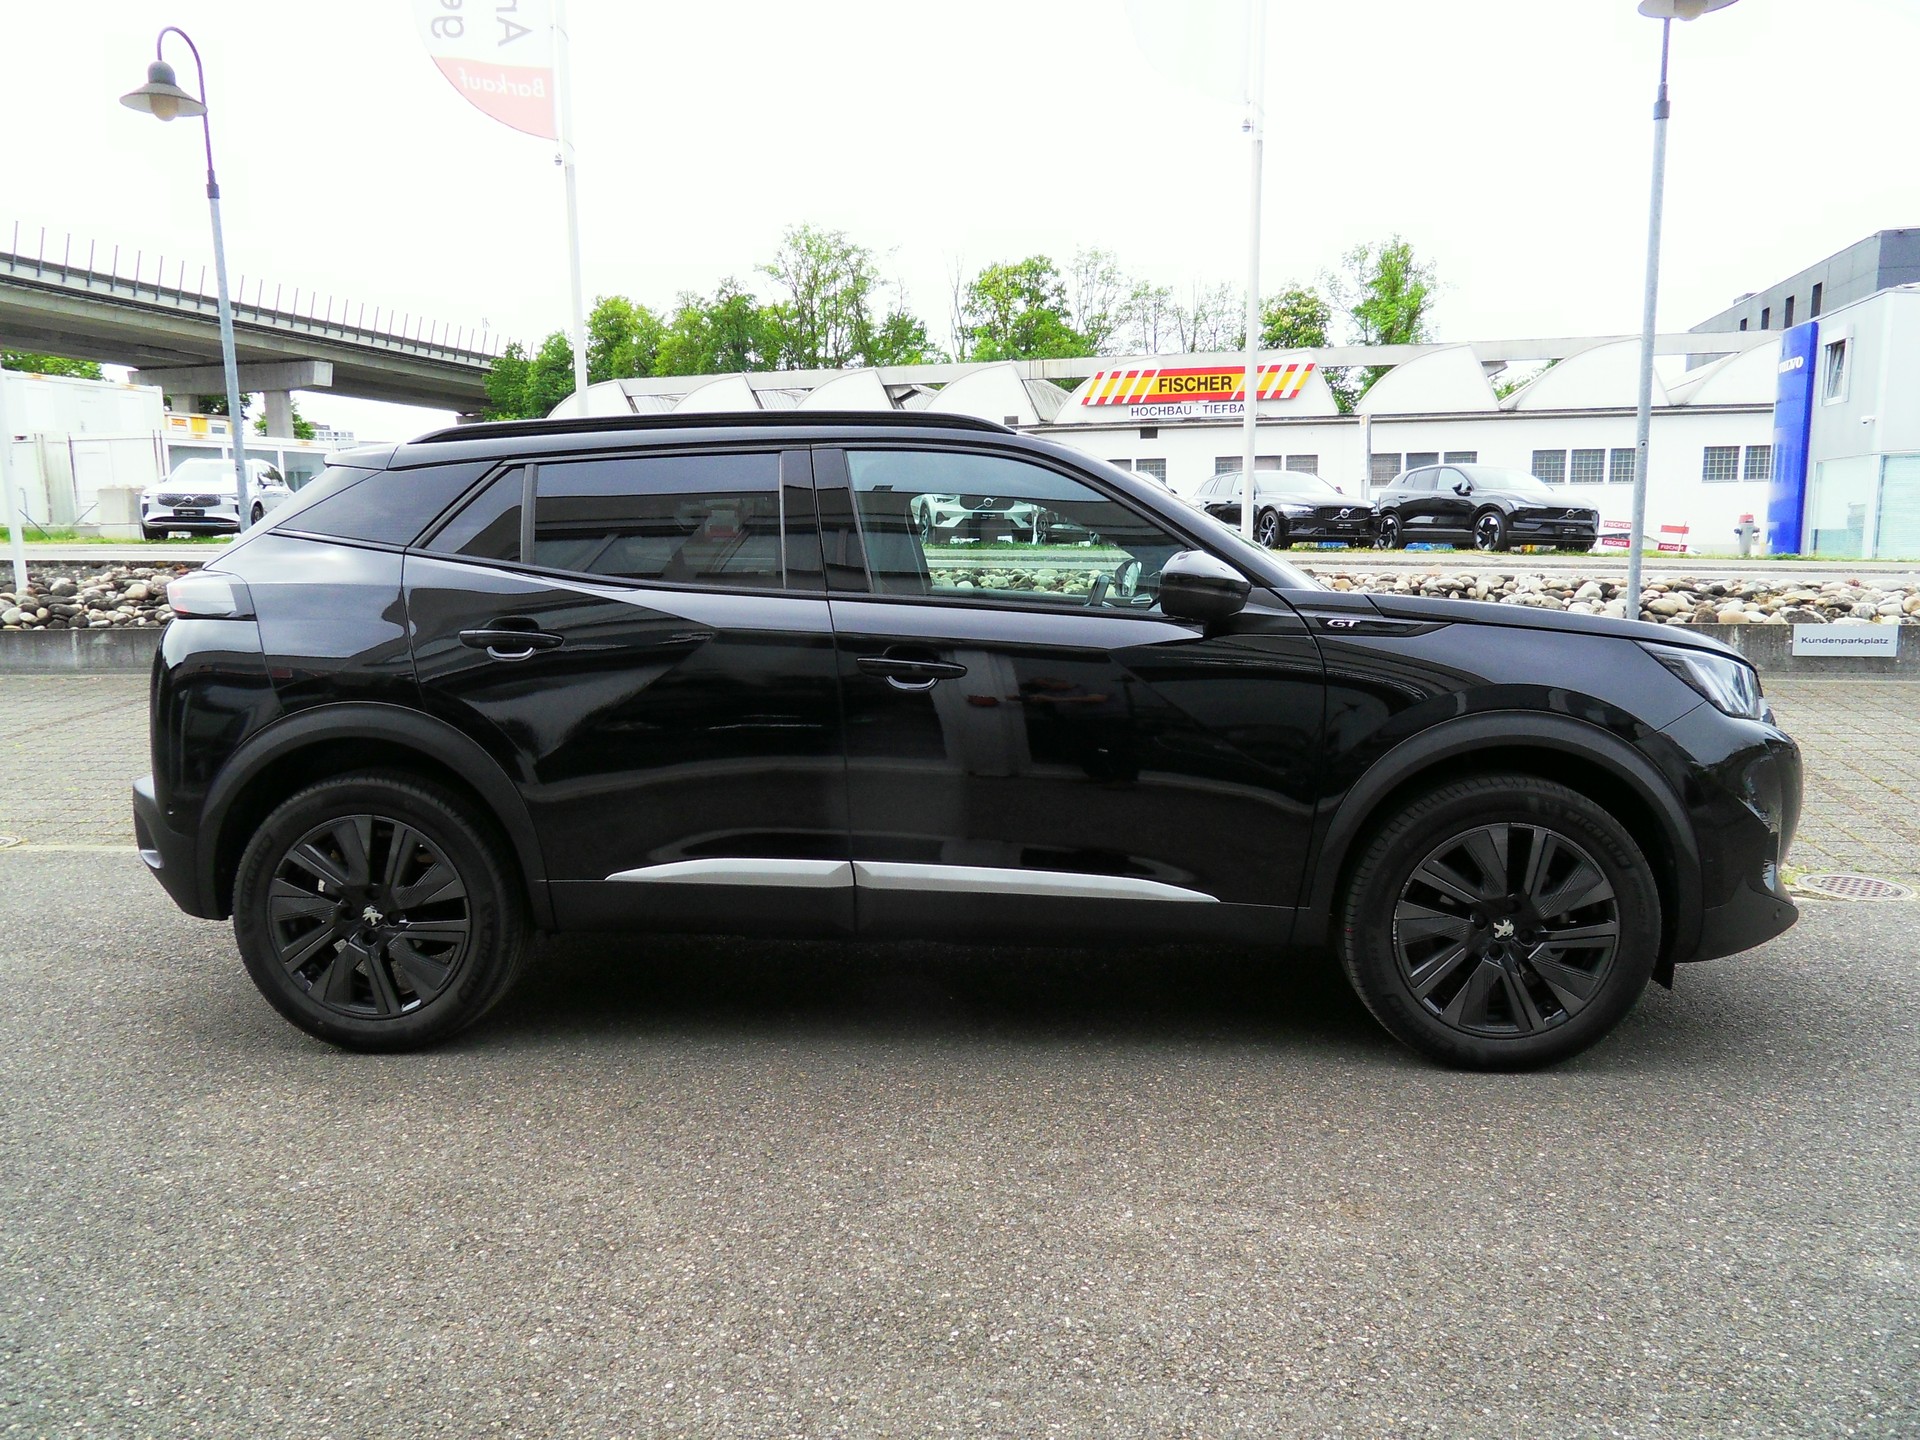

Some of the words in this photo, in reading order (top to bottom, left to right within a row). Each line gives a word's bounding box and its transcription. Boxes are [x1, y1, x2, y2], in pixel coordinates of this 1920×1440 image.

[1159, 376, 1232, 393] FISCHER
[1131, 405, 1192, 416] HOCHBAU
[1203, 404, 1245, 414] TIEFBA
[1327, 619, 1360, 628] GT
[1801, 637, 1888, 645] Kundenparkplatz
